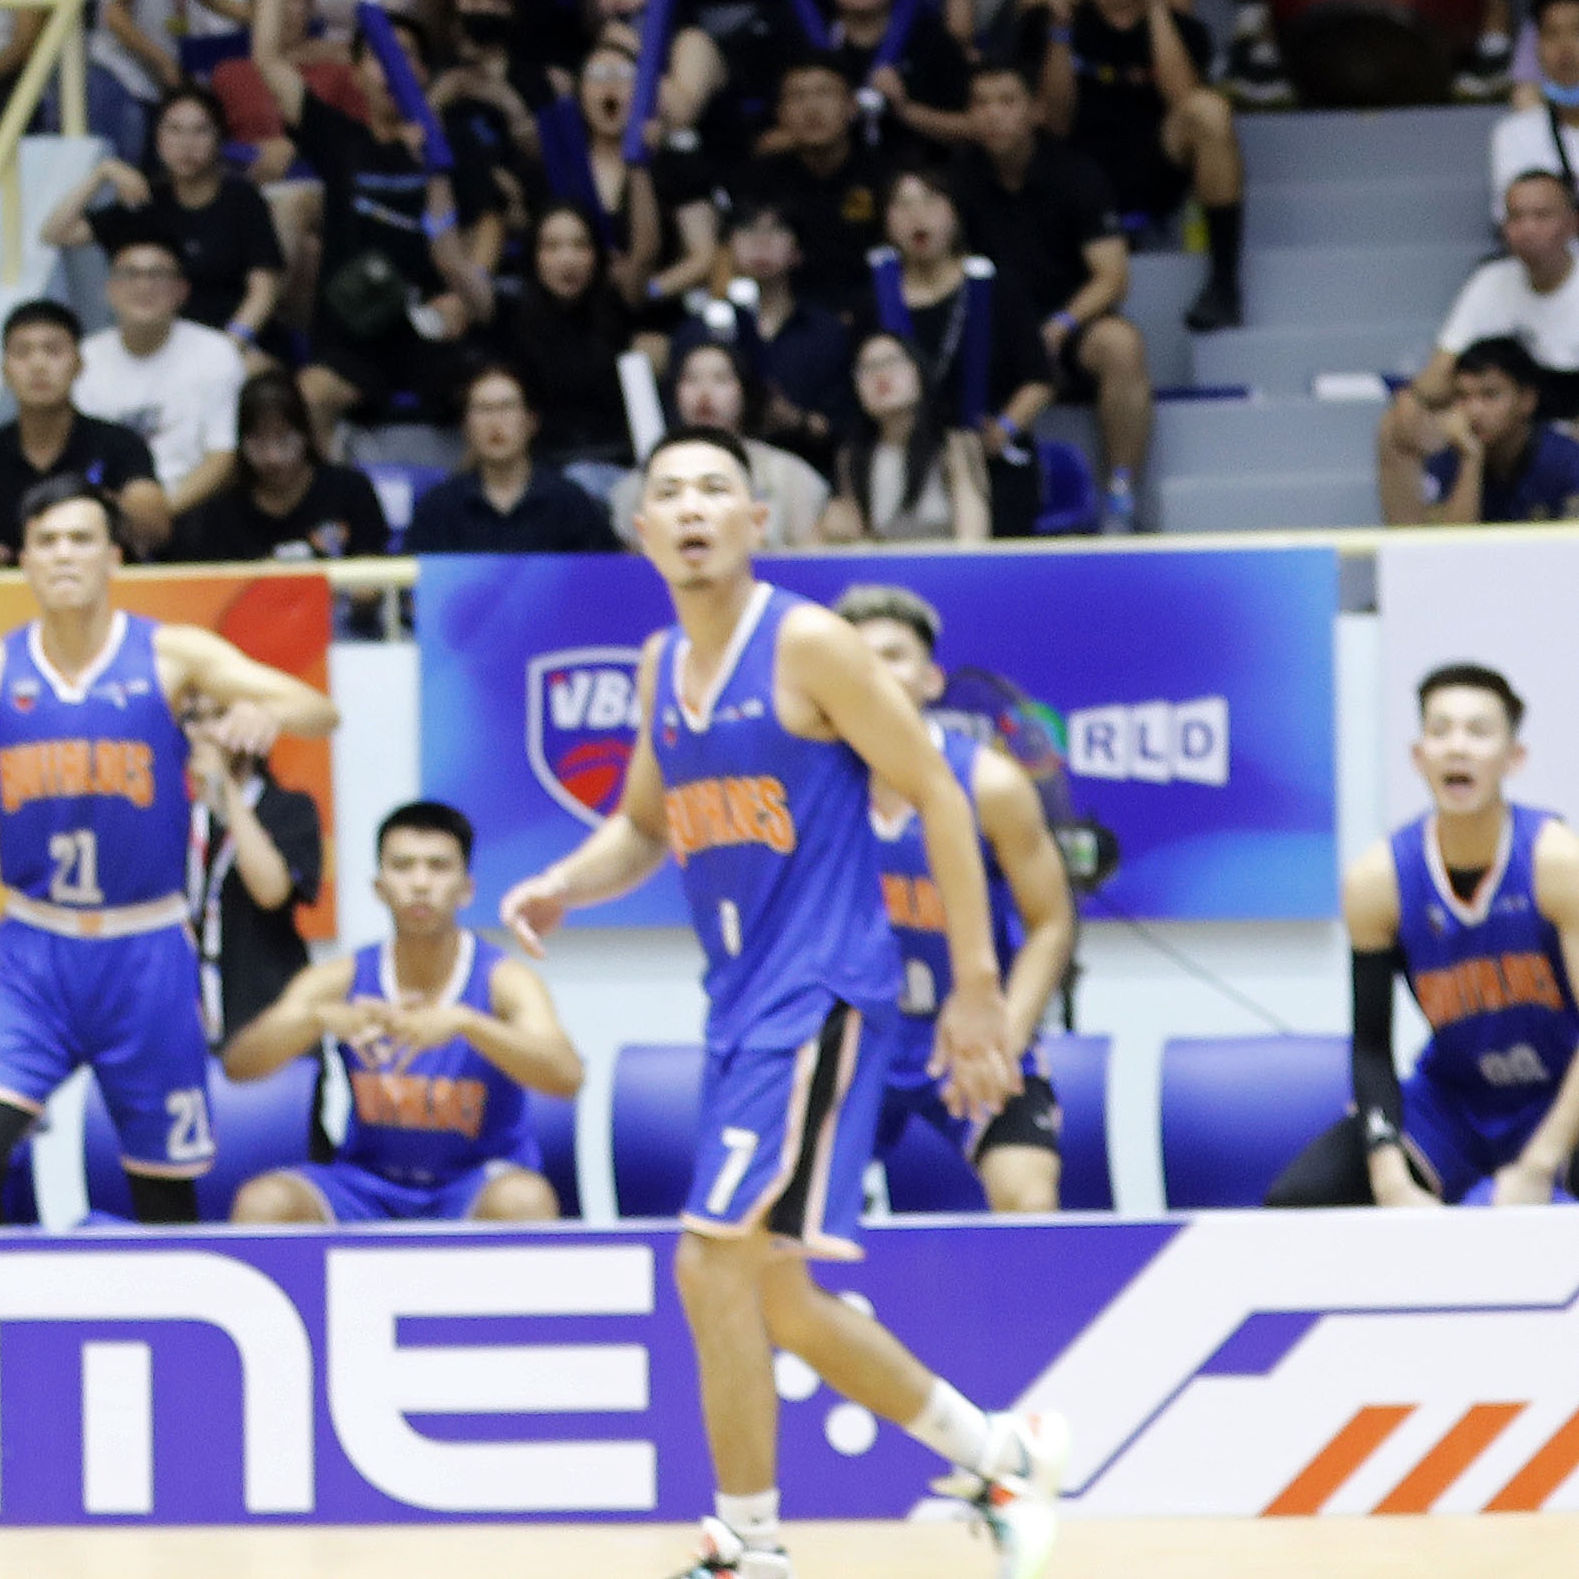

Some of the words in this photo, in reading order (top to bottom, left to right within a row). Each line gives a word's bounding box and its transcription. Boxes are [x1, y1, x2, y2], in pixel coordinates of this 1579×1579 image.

[1084, 718, 1215, 763] RLD
[48, 828, 105, 905] 21
[164, 1087, 215, 1163] 21
[704, 1127, 759, 1215] 7
